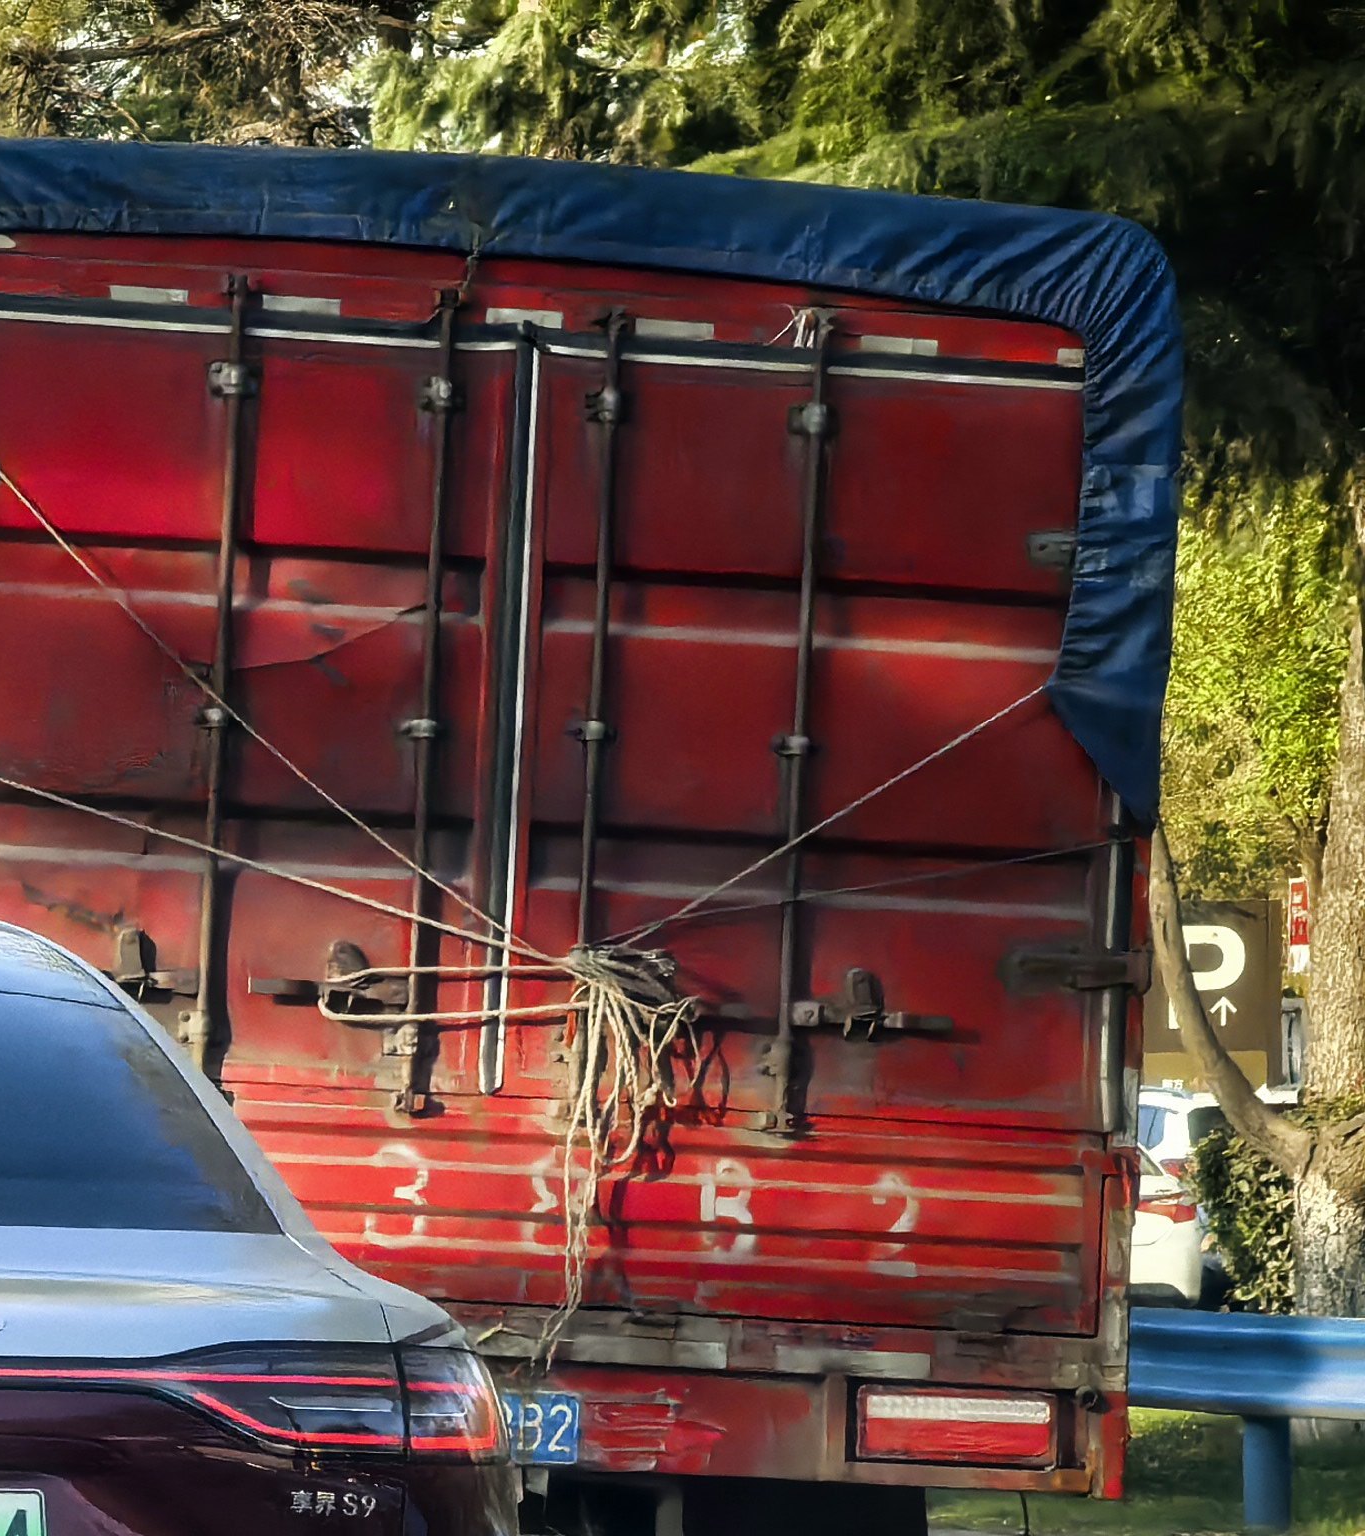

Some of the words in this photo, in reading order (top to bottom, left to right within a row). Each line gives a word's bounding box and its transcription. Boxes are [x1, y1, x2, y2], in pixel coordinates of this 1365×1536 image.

[1168, 925, 1246, 1030] P
[290, 1490, 337, 1516] 享界
[342, 1492, 377, 1518] S9
